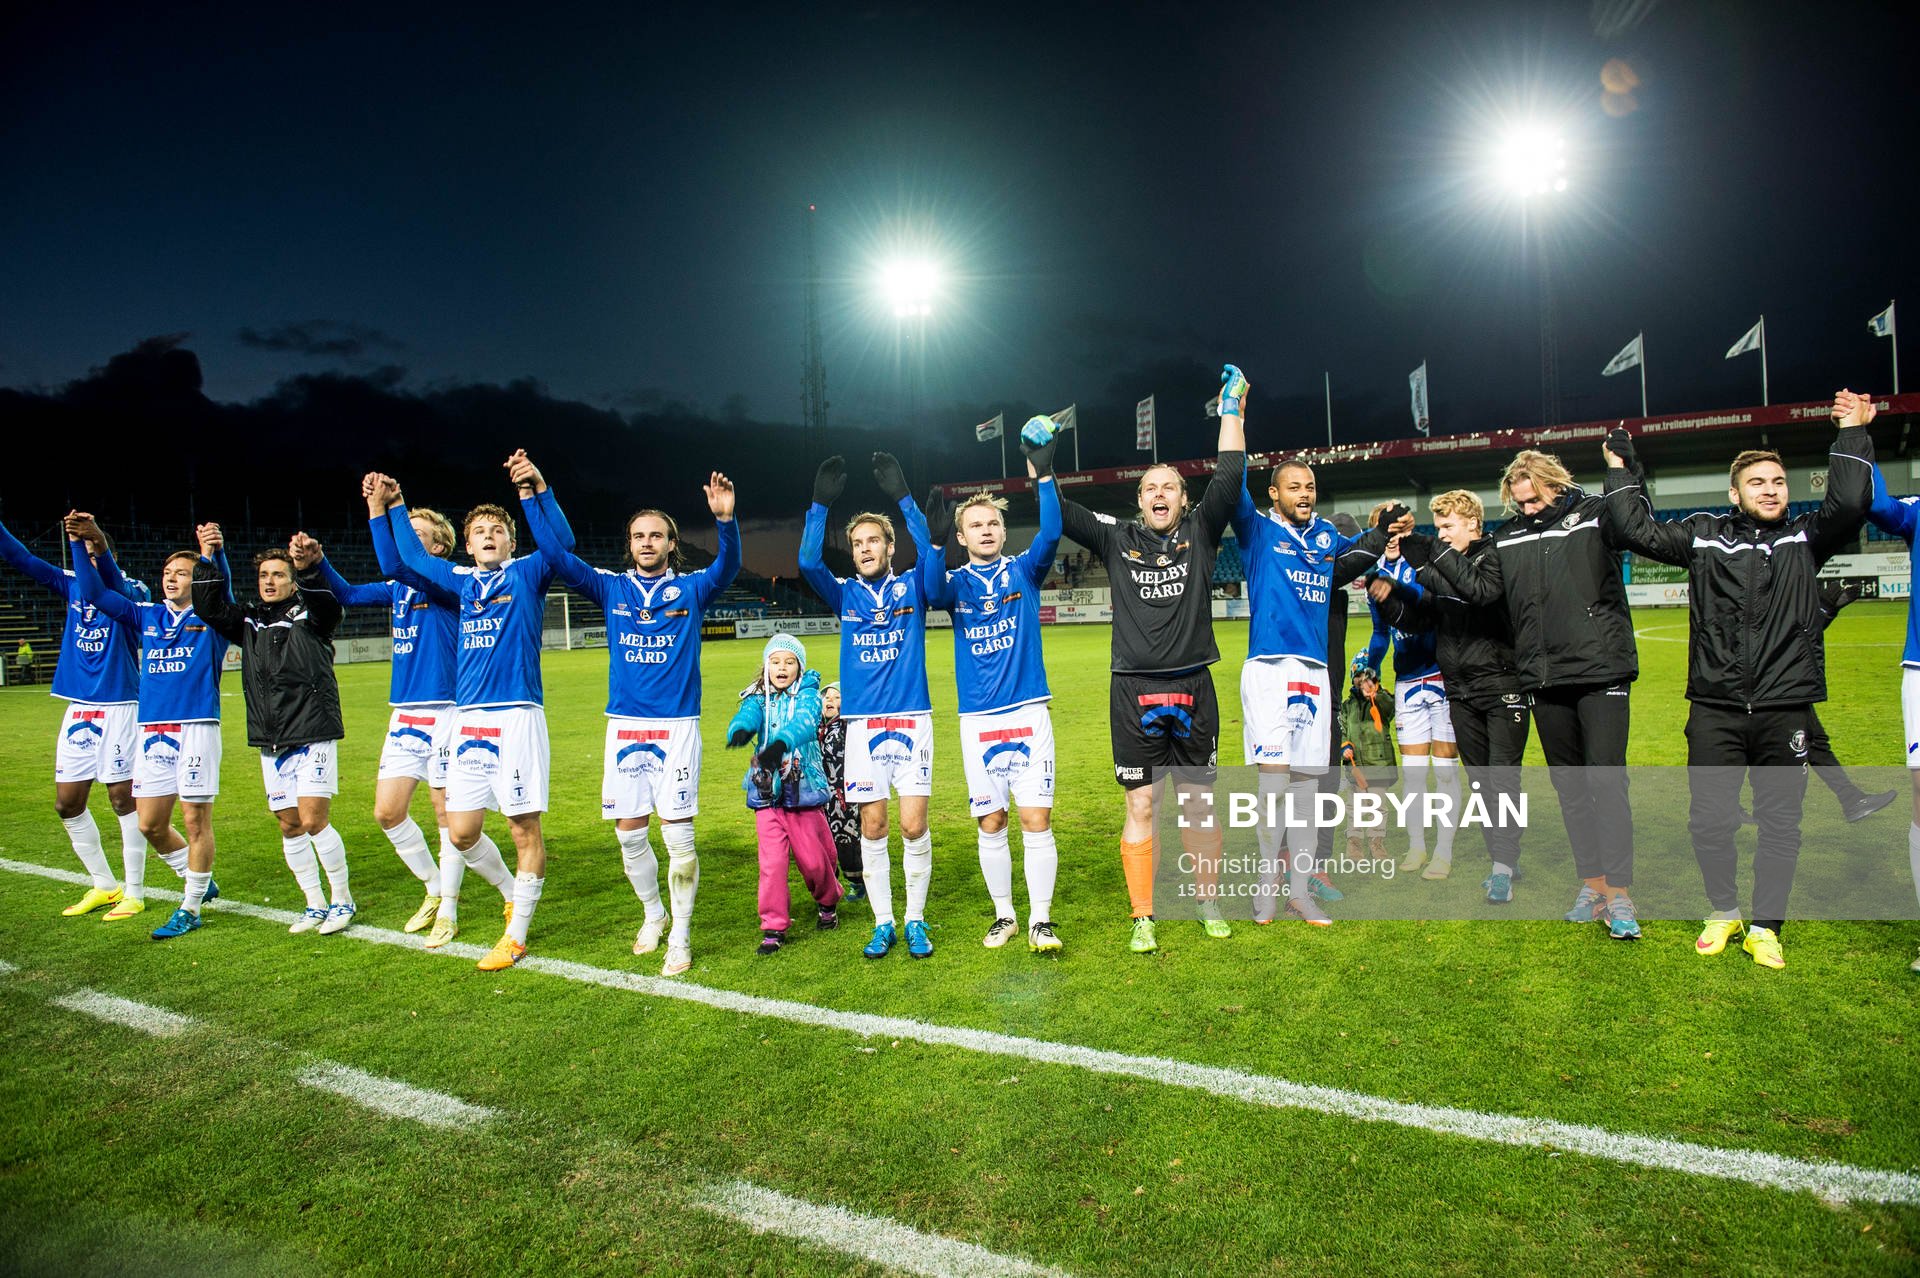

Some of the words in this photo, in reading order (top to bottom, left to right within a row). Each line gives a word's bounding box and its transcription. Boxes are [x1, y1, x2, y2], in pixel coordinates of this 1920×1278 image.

[1642, 412, 1752, 433] www.trelleborgsallehanda.se
[1533, 429, 1573, 441] Trelleborgs
[1573, 426, 1607, 438] Allehanda
[1422, 440, 1458, 451] Trelleborgs
[1459, 436, 1491, 448] Allehanda
[1130, 562, 1189, 585] MELLBY
[1285, 568, 1329, 589] MELLBY
[1140, 582, 1185, 600] GÅRD
[964, 615, 1017, 640] MELLBY
[464, 634, 496, 650] GÅRD
[618, 632, 677, 648] MELLBY
[853, 629, 905, 647] MELLBY
[971, 635, 1014, 656] GÅRD
[625, 648, 668, 664] GÅRD
[860, 647, 900, 663] GÅRD
[148, 660, 186, 674] GÅRD
[114, 744, 121, 756] 3
[438, 746, 450, 758] 16
[919, 749, 930, 762] 10
[188, 755, 202, 768] 22
[314, 752, 327, 764] 28
[1043, 759, 1053, 774] 11
[513, 768, 521, 781] 4
[675, 767, 690, 782] 25
